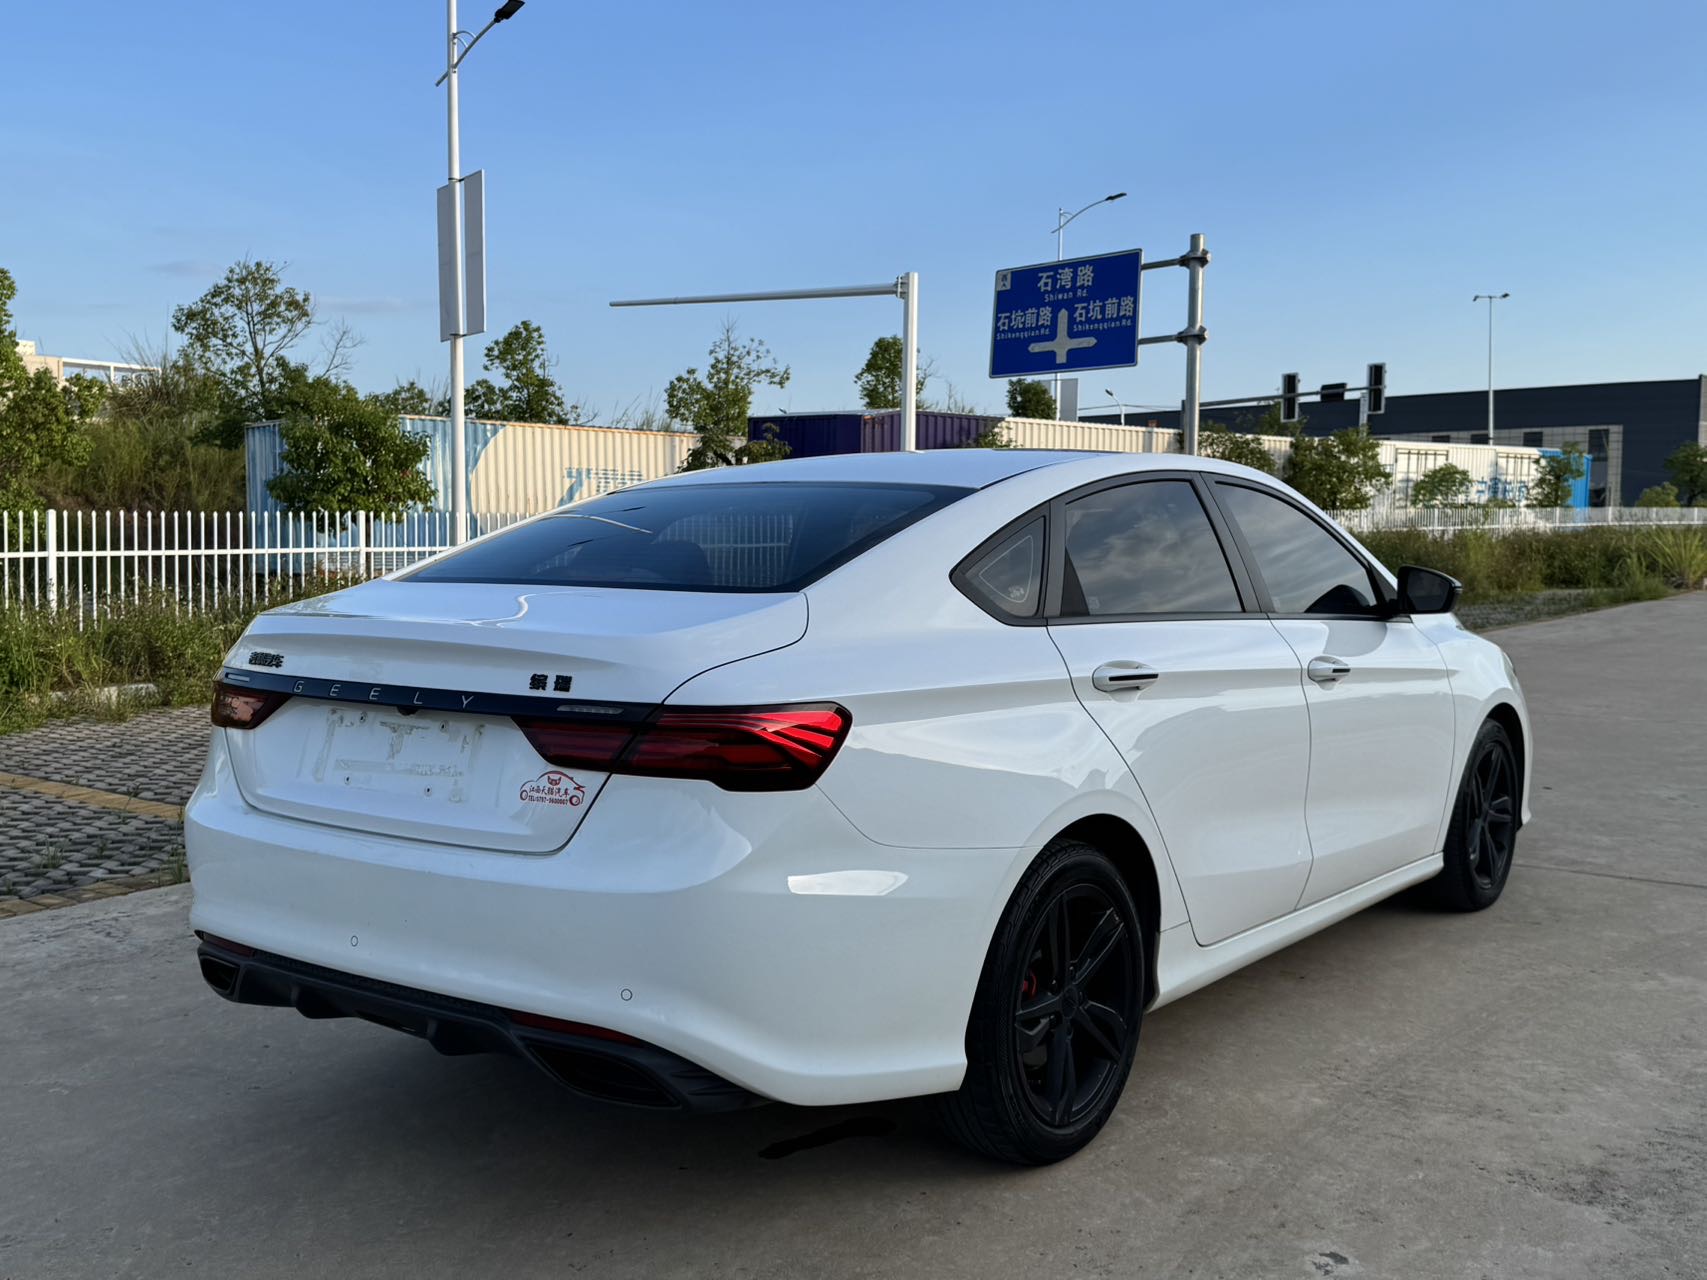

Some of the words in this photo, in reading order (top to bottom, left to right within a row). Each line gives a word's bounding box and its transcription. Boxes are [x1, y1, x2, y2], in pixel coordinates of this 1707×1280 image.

[1037, 264, 1094, 292] 石湾路
[1044, 291, 1073, 302] Shiwan
[1073, 296, 1134, 322] 石坑前路
[997, 306, 1052, 331] 石坑前路
[292, 680, 475, 709] GEELY
